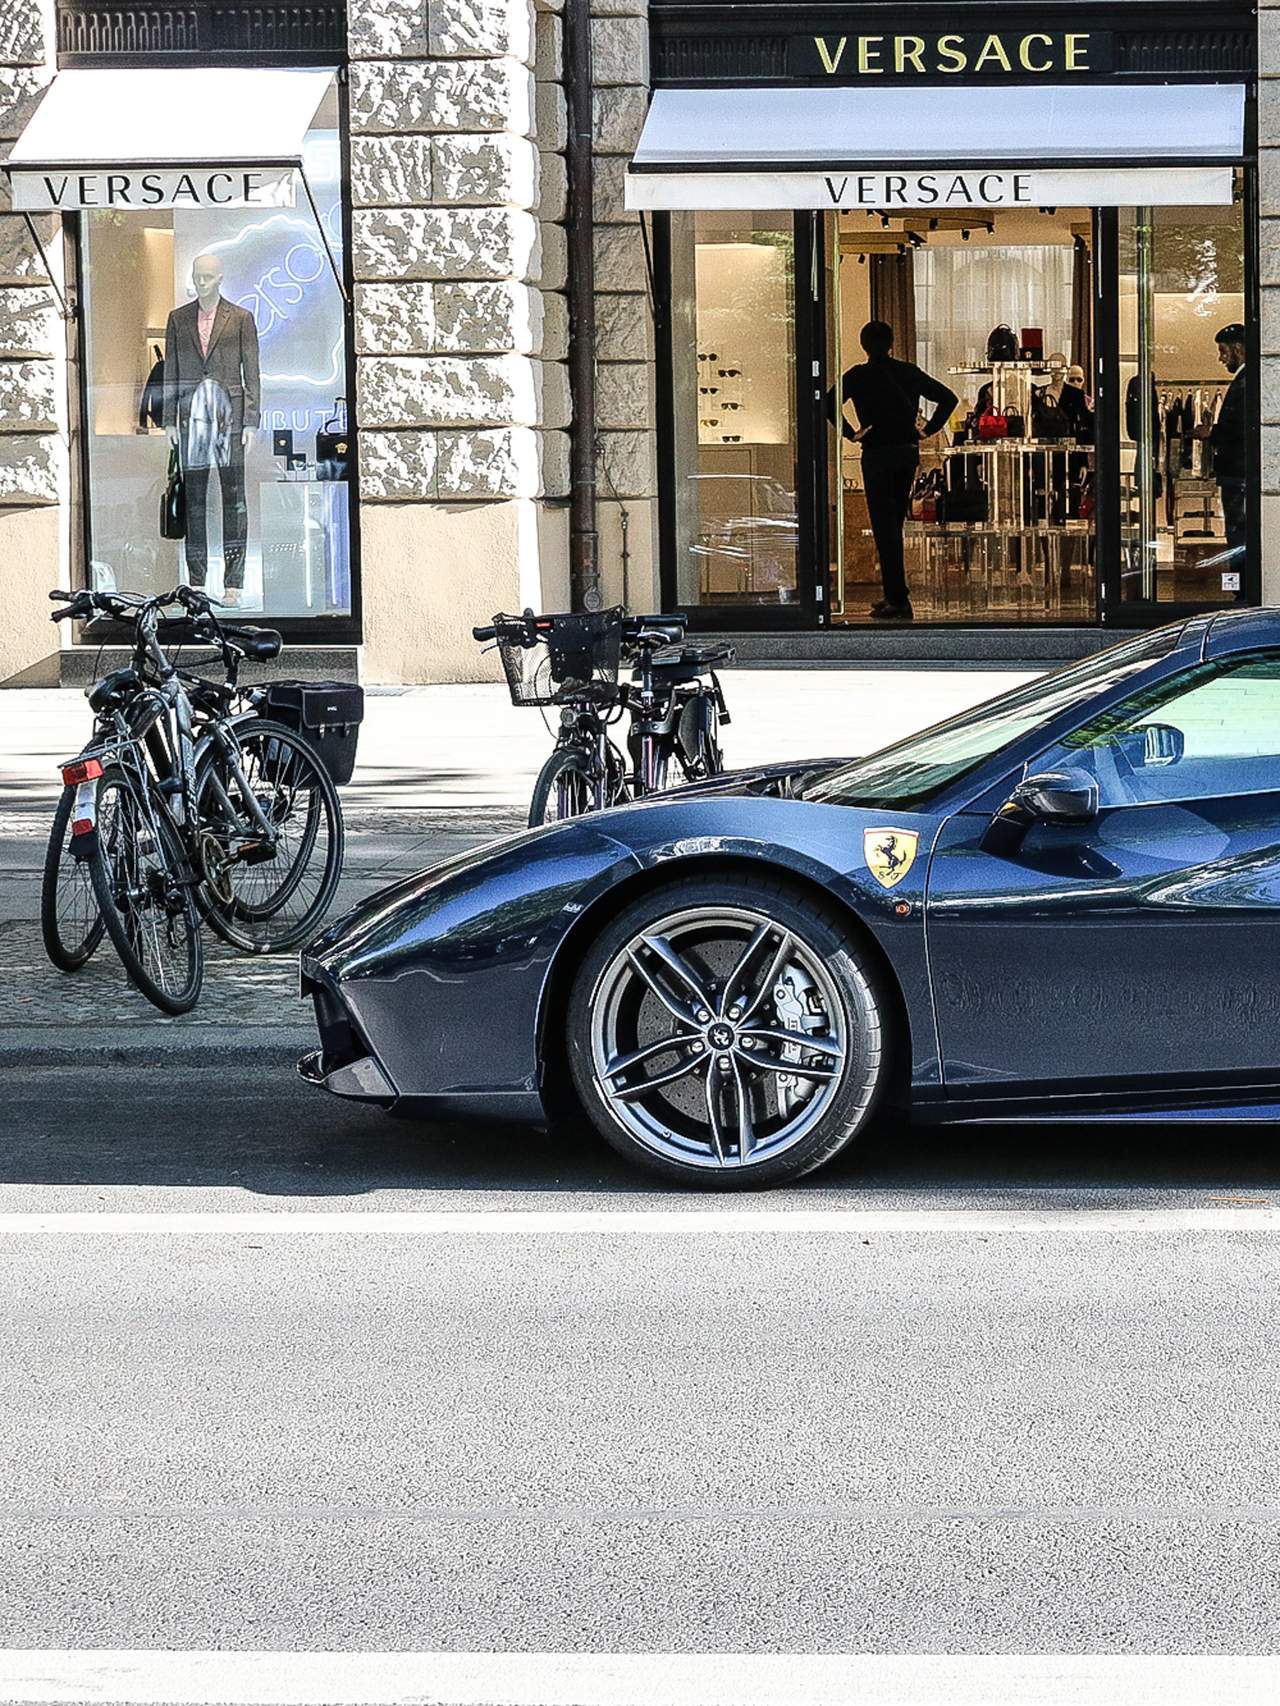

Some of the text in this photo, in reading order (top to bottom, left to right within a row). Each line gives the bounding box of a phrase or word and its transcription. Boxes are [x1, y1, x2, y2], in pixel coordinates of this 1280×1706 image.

[814, 33, 1090, 74] VERSACE
[43, 173, 263, 206] VERSACE
[824, 174, 1032, 204] VERSACE
[877, 871, 886, 880] S
